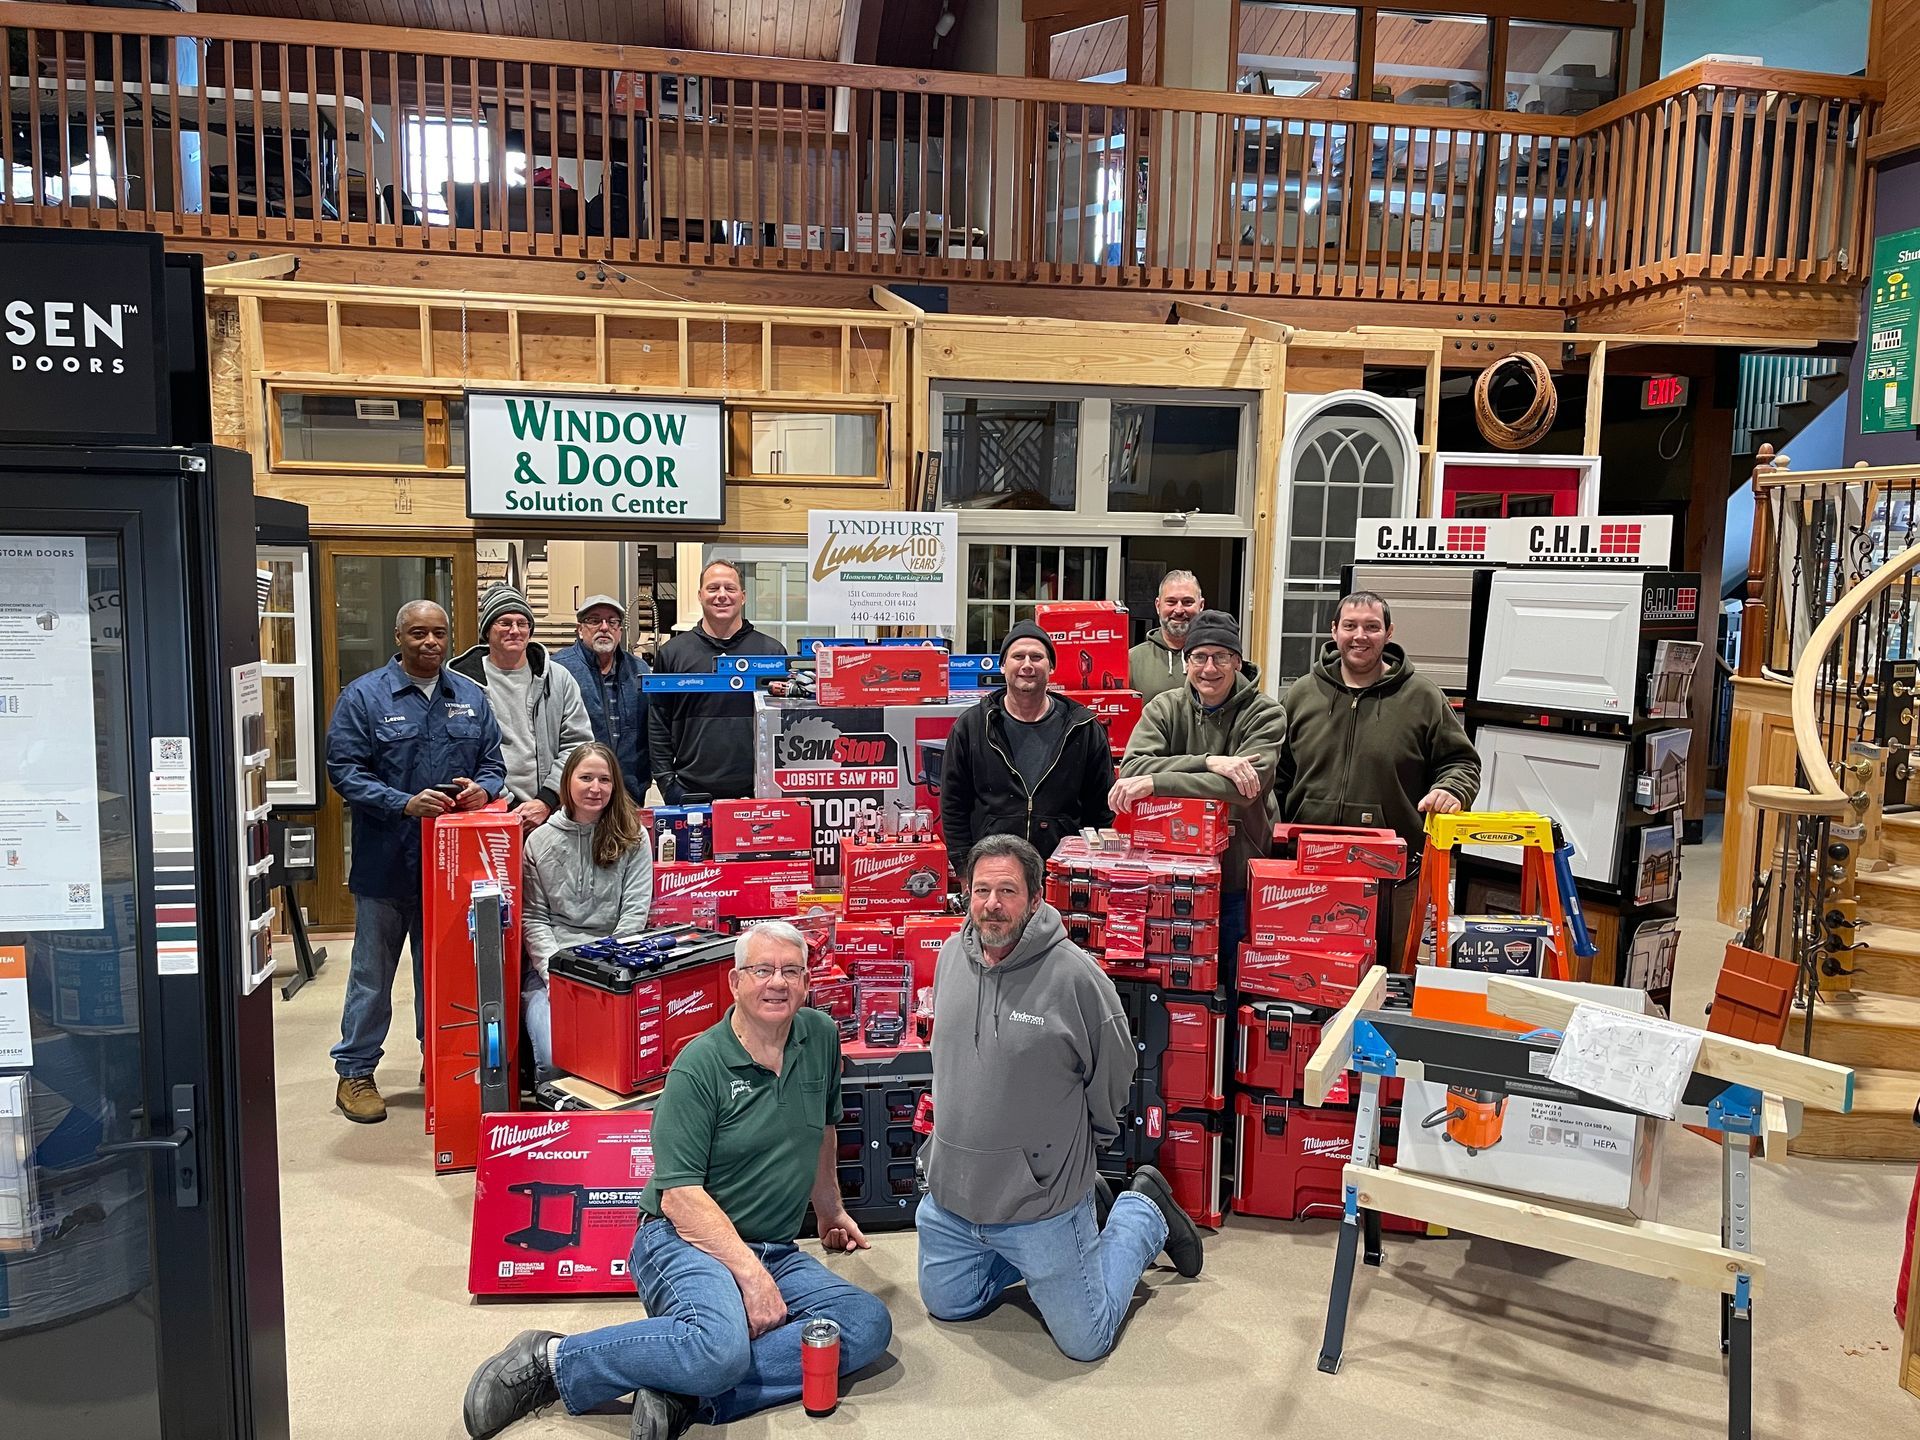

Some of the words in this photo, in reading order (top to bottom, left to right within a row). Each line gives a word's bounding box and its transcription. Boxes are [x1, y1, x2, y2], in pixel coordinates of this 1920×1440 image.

[12, 355, 125, 374] DOORS
[1648, 378, 1678, 406] EXIT
[514, 451, 547, 485] &
[505, 489, 603, 512] Solution
[611, 493, 688, 515] Center
[828, 519, 944, 536] LYNDHURST
[1377, 525, 1445, 551] C.H.I.
[1529, 525, 1597, 554] C.H.I.
[909, 537, 937, 557] 100
[36, 550, 75, 558] DOORS
[812, 532, 911, 583] Lumber
[909, 558, 937, 570] YEARS
[877, 573, 894, 581] Pride
[895, 574, 921, 582] Working
[861, 590, 901, 598] Commodore
[850, 611, 916, 622] 440-442-1616
[1068, 629, 1123, 641] FUEL
[786, 735, 887, 765] SawStop
[782, 772, 835, 787] JOBSITE
[839, 772, 866, 785] SAW
[870, 771, 894, 784] PRO
[751, 810, 791, 818] FUEL
[1135, 801, 1183, 816] Milwaukee
[1305, 843, 1344, 855] Milwaukee
[850, 852, 917, 878] Milwaukee
[656, 867, 722, 893] Milwaukee
[690, 889, 741, 899] PACKOUT
[1258, 883, 1329, 904] Milwaukee
[921, 940, 942, 948] M18
[1276, 935, 1321, 943] TOOL-ONLY
[844, 944, 888, 952] FUEL
[1243, 950, 1291, 964] Milwaukee
[666, 990, 704, 1015] Milwaukee
[685, 1003, 714, 1015] PACKOUT
[1009, 1010, 1045, 1022] Andersen
[486, 1119, 570, 1150] Milwaukee
[1301, 1137, 1350, 1150] Milwaukee
[1593, 1139, 1617, 1150] HEPA
[527, 1151, 592, 1160] PACKOUT
[588, 1192, 625, 1200] MOST
